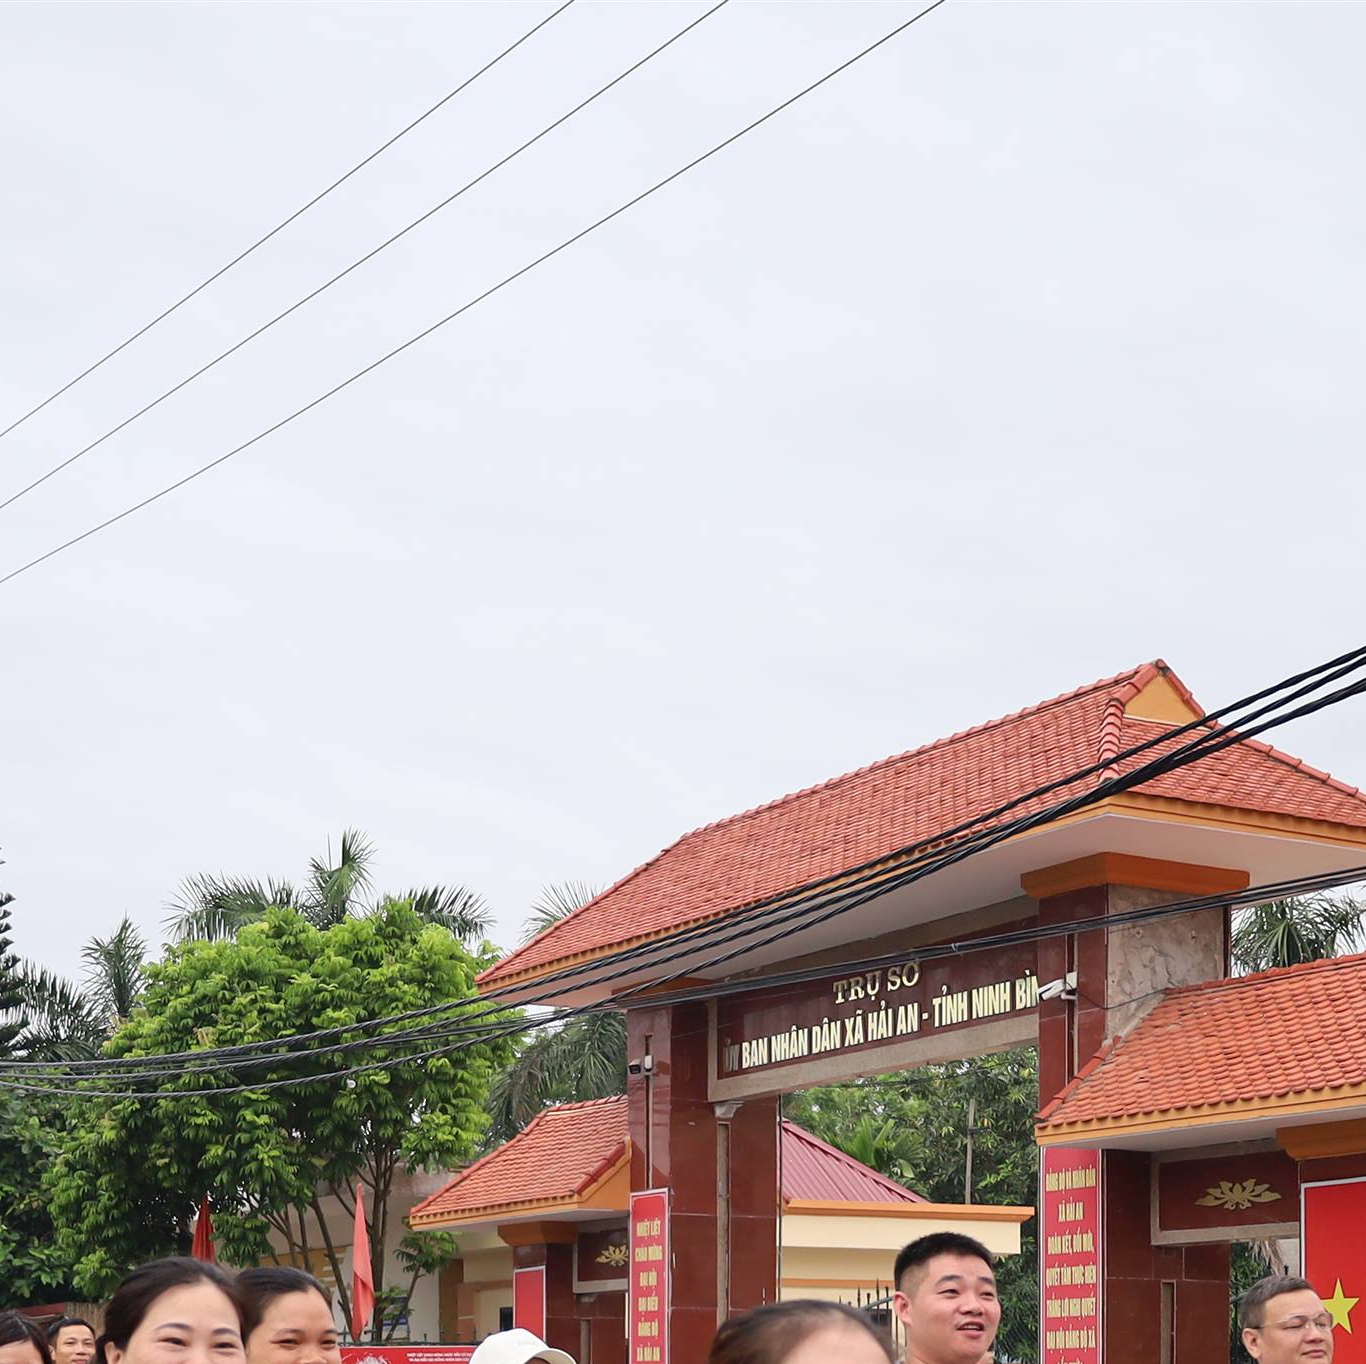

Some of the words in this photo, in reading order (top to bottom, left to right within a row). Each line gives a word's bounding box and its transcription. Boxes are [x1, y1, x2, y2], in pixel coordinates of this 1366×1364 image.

[833, 970, 881, 1005] TRỤ
[742, 1037, 768, 1069] BAN
[771, 1023, 808, 1063] NHÂN
[812, 1017, 841, 1054] DÂN
[844, 1009, 865, 1046] XÃ
[867, 999, 893, 1040] HẢI
[896, 1002, 918, 1035] AN
[932, 984, 968, 1028] TỈNH
[972, 981, 1011, 1020] NINH
